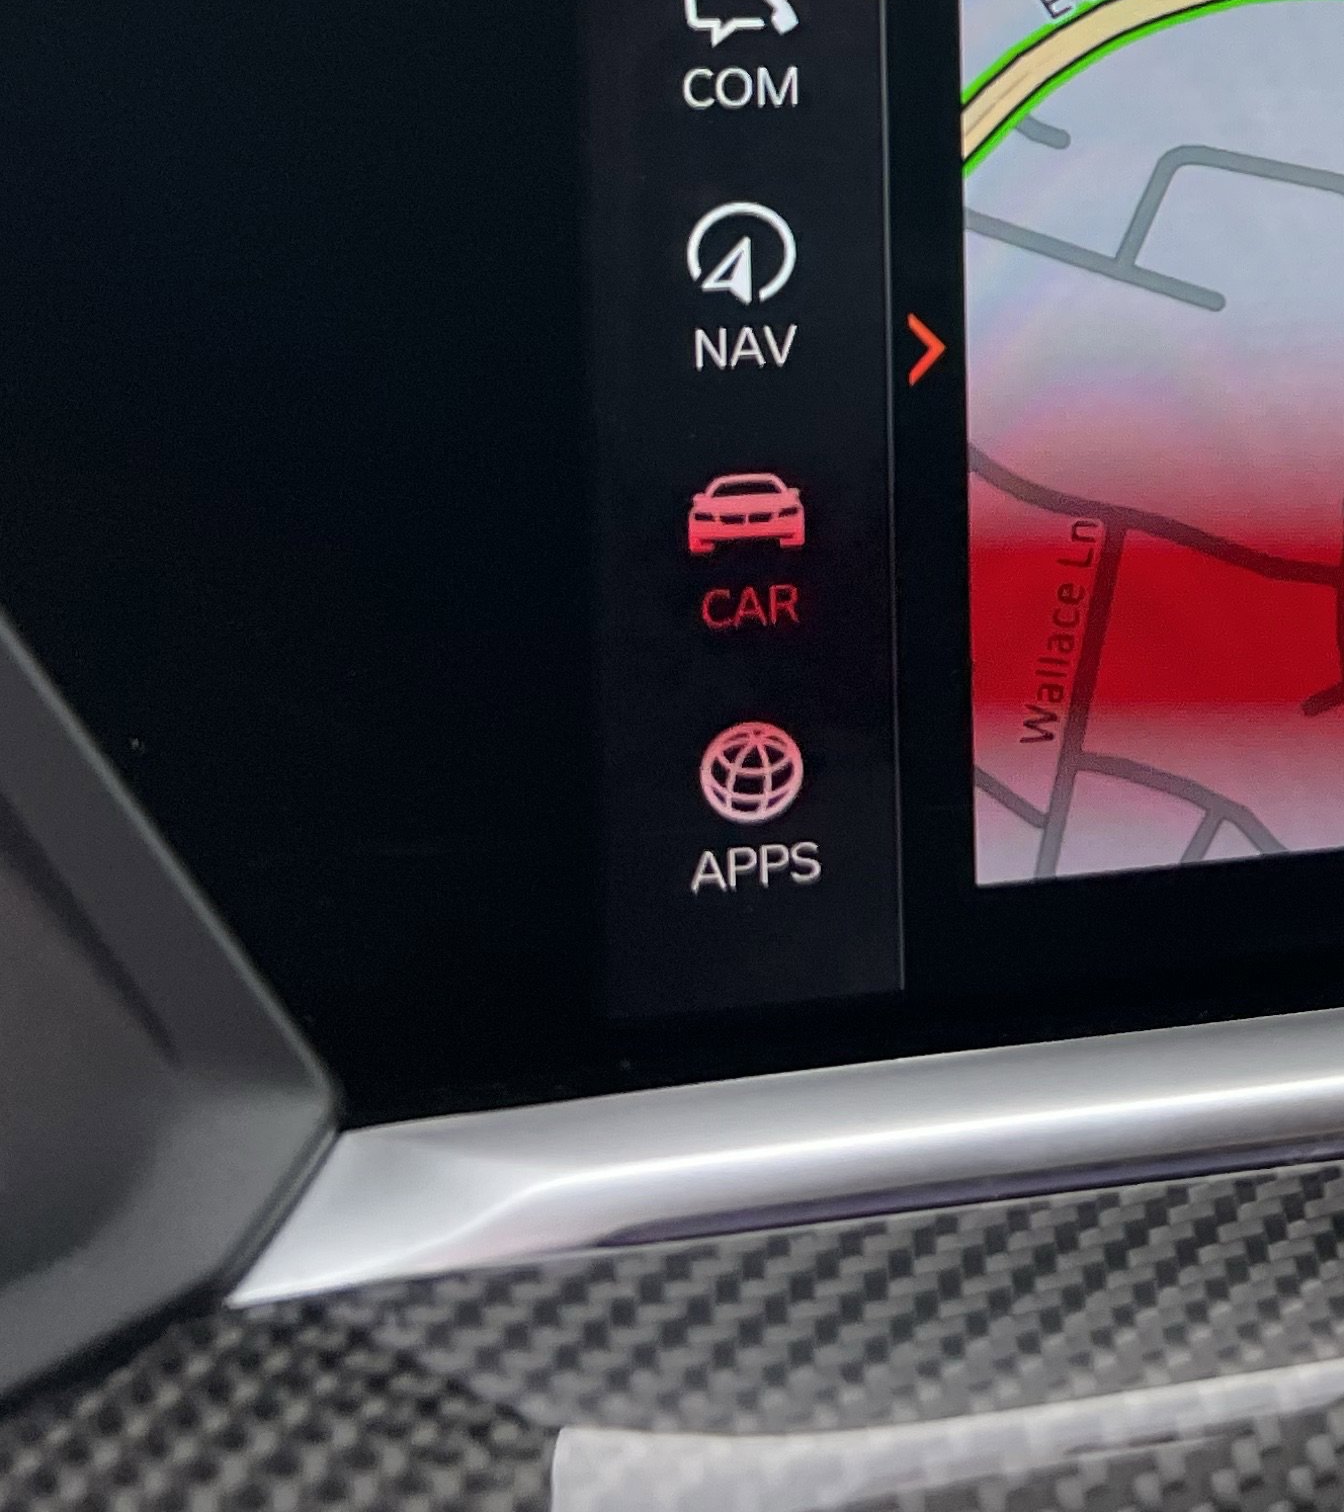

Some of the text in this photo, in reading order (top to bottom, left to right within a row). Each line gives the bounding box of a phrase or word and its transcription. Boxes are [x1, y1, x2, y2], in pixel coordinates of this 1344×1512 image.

[682, 66, 800, 109] COM
[693, 324, 797, 371] NAV
[701, 584, 799, 630] CAR
[1019, 520, 1097, 746] Wallace Ln
[690, 840, 822, 895] APPS
